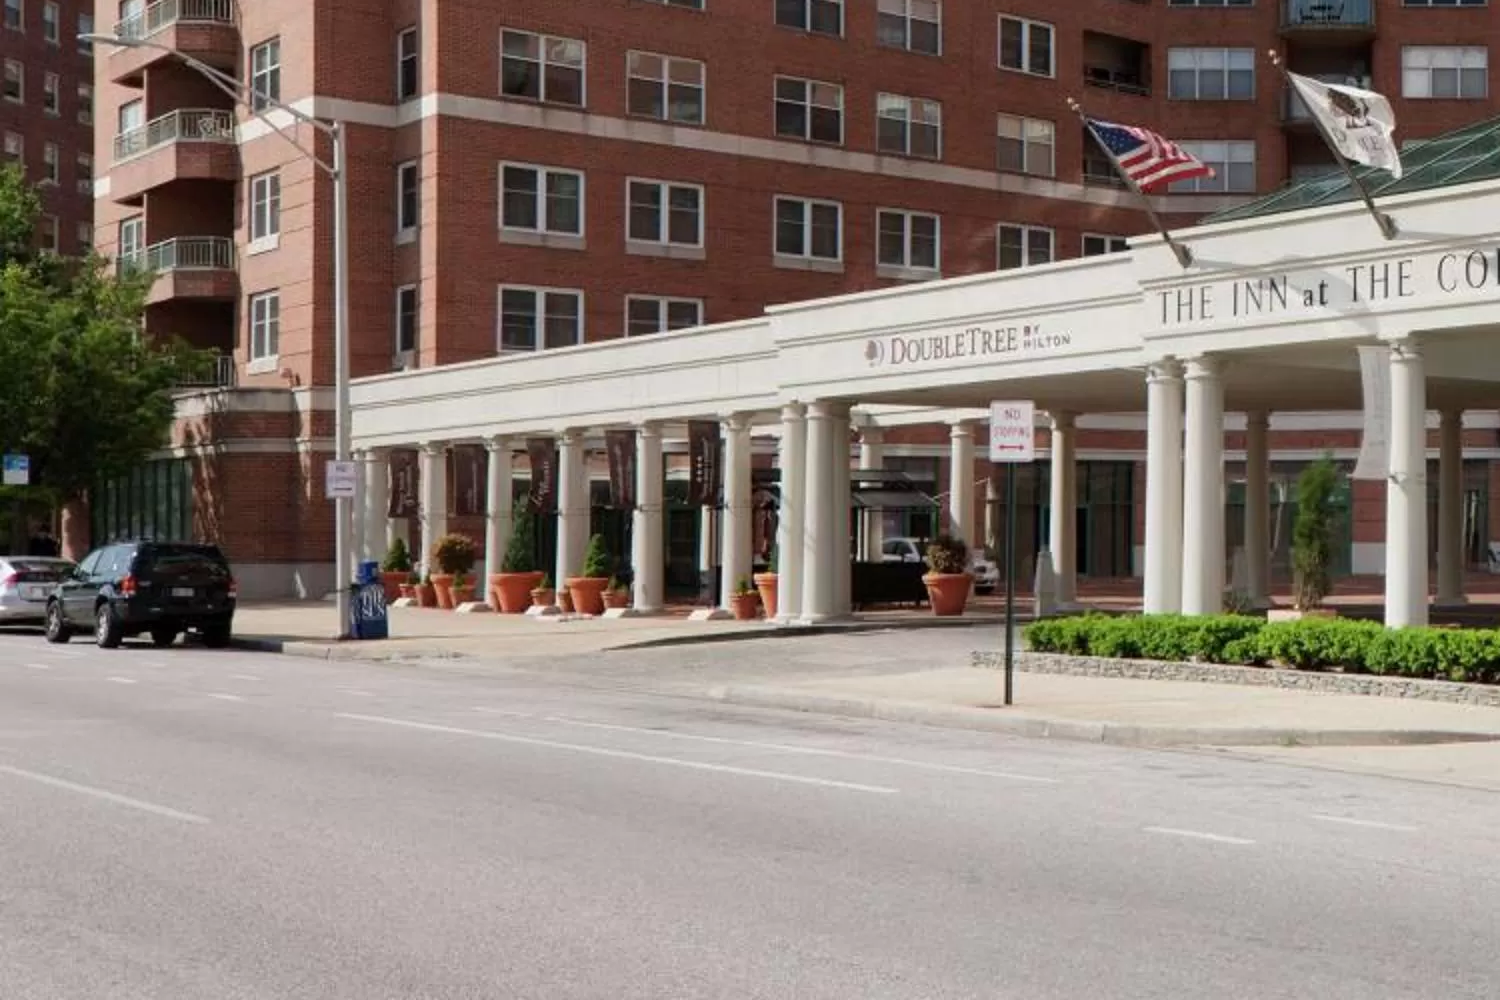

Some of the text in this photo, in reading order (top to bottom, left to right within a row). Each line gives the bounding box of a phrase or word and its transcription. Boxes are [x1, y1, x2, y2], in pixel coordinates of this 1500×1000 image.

[1158, 285, 1214, 324] THE
[1233, 275, 1288, 316] INN
[1303, 279, 1328, 307] at
[1346, 259, 1415, 303] THE
[1023, 333, 1071, 350] HILTON
[1004, 409, 1021, 420] NO
